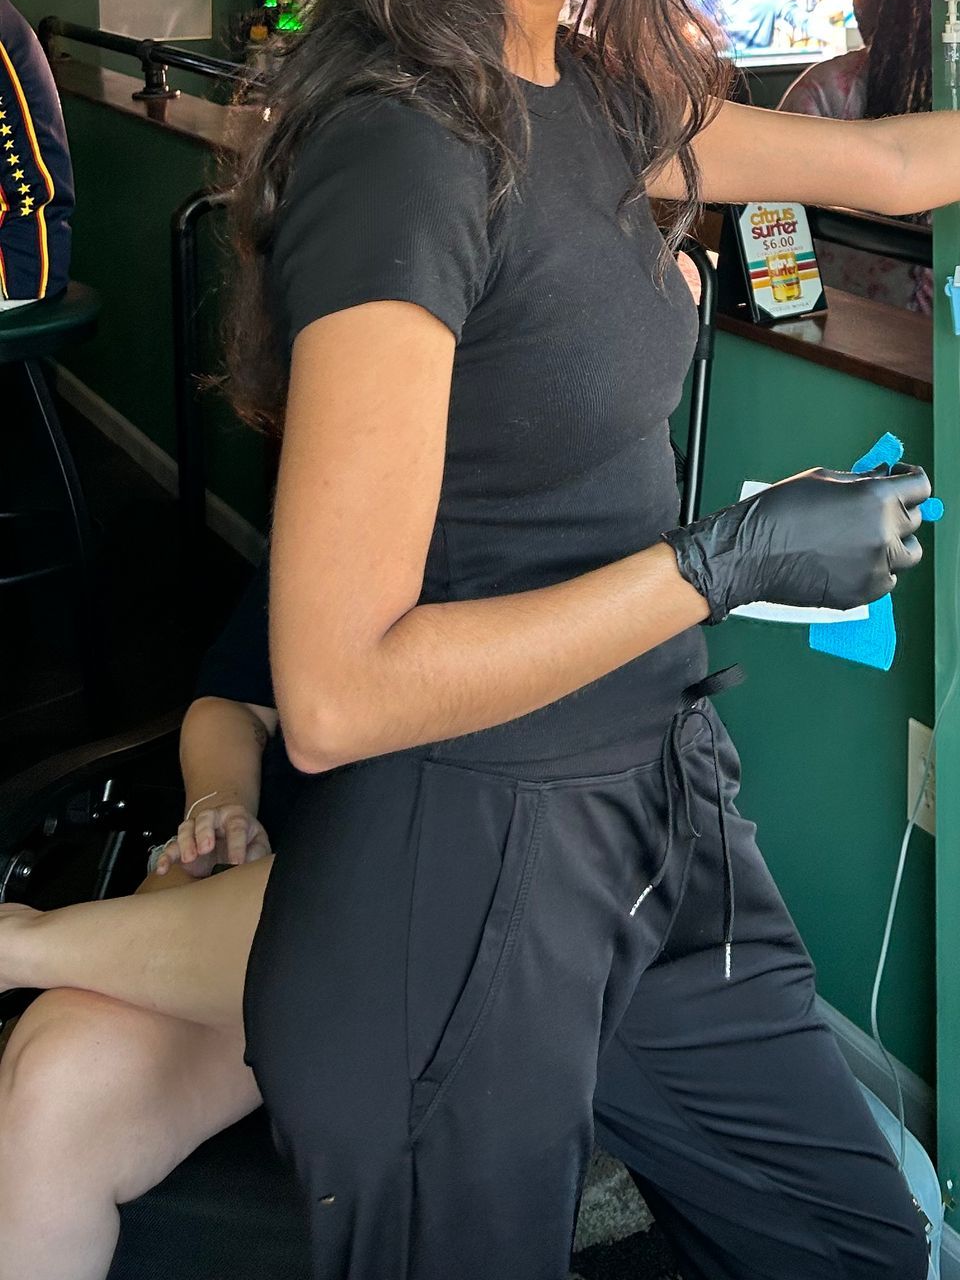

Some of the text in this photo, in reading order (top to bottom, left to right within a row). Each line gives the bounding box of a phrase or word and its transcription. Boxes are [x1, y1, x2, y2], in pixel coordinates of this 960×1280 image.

[750, 206, 796, 226] citrus
[751, 217, 799, 240] surfer
[763, 236, 795, 251] $6.00
